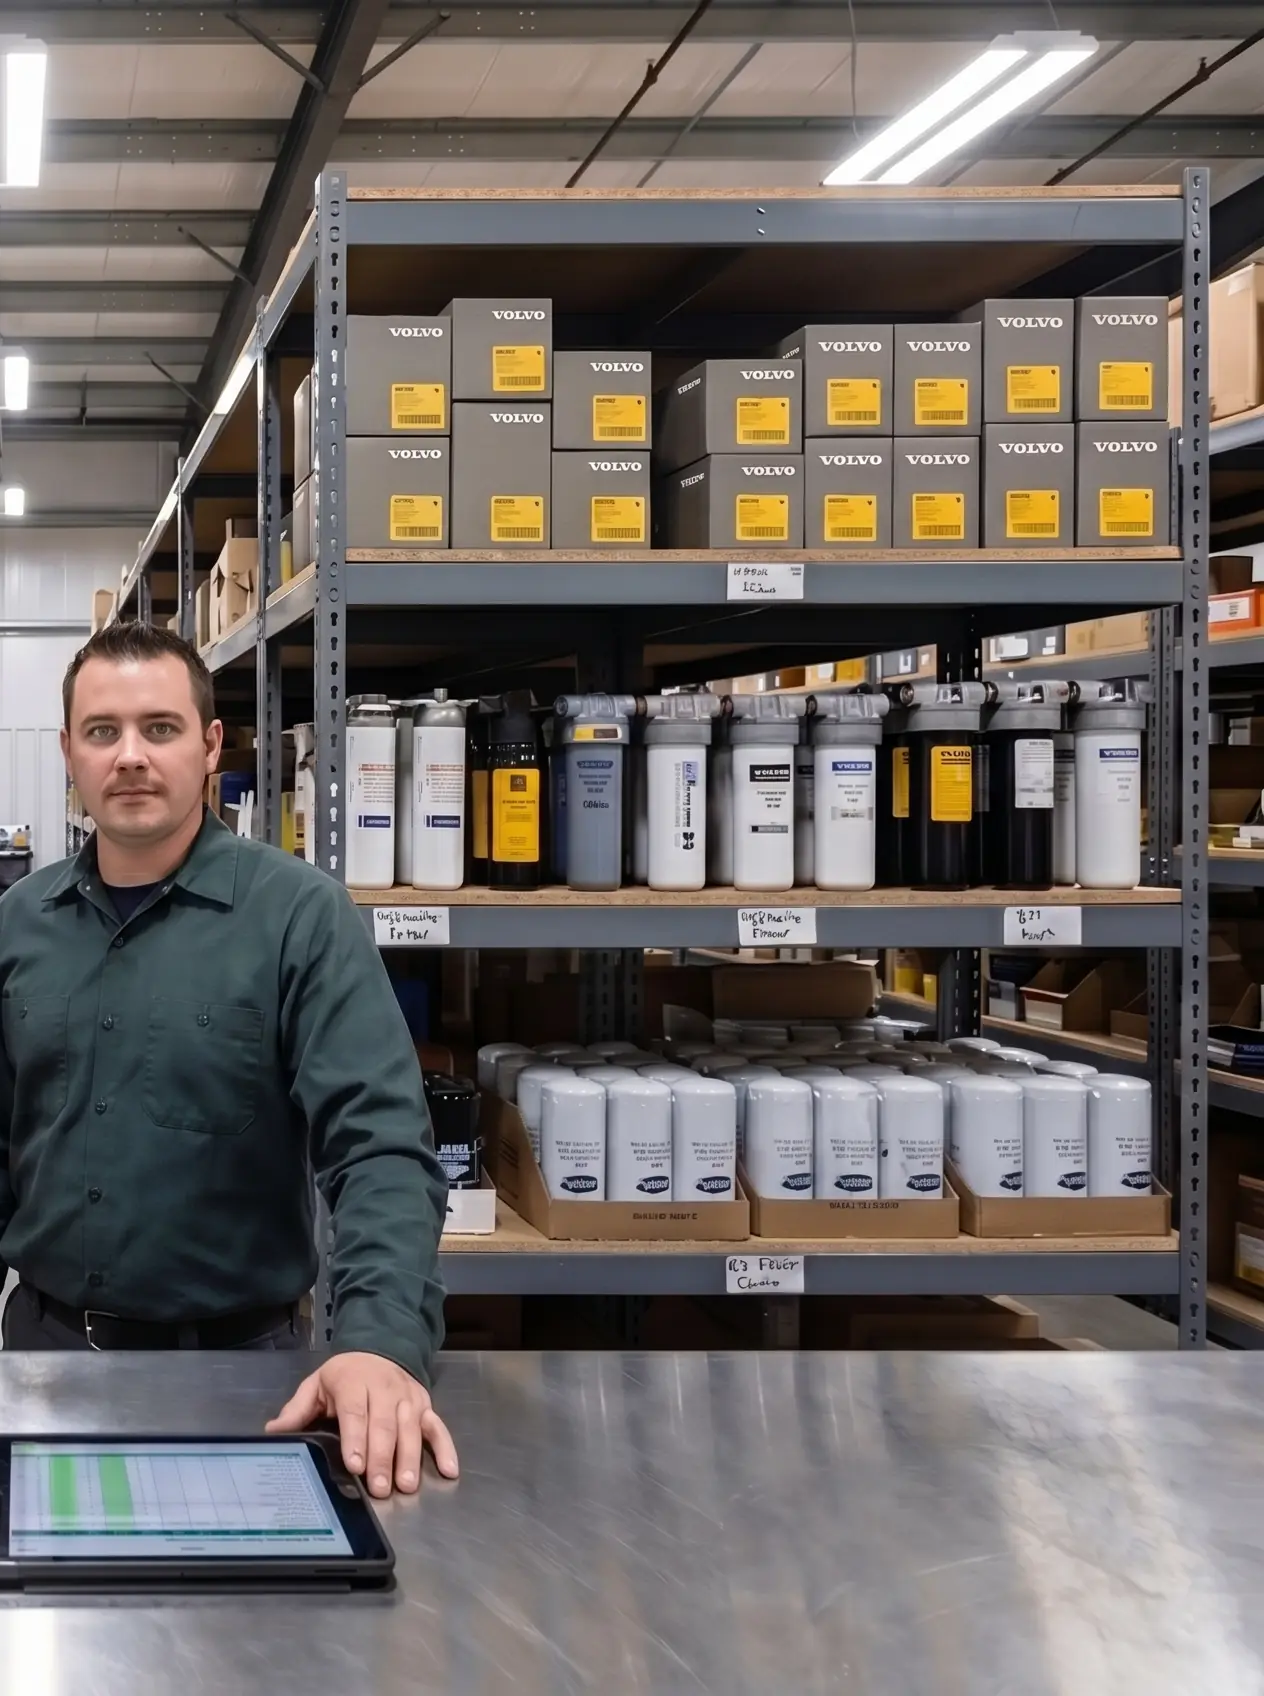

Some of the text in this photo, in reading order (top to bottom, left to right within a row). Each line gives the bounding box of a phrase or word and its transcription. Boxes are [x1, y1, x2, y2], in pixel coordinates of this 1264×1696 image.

[492, 310, 546, 320] VOLVO
[1092, 314, 1159, 326] VOLVO
[997, 317, 1064, 328] VOLVO
[389, 327, 443, 338] VOLVO
[818, 341, 882, 353] VOLVO
[907, 341, 971, 352] VOLVO
[590, 362, 644, 373] VOLVO
[740, 369, 795, 380] VOLVO
[490, 413, 544, 424] VOLVO
[998, 442, 1064, 454] VOLVO
[1093, 441, 1158, 453] VOLVO
[388, 449, 442, 459] VOLVO
[905, 454, 970, 465] VOLVO
[820, 454, 883, 466] VOLVO
[588, 461, 642, 472] VOLVO
[741, 466, 796, 476] VOLVO
